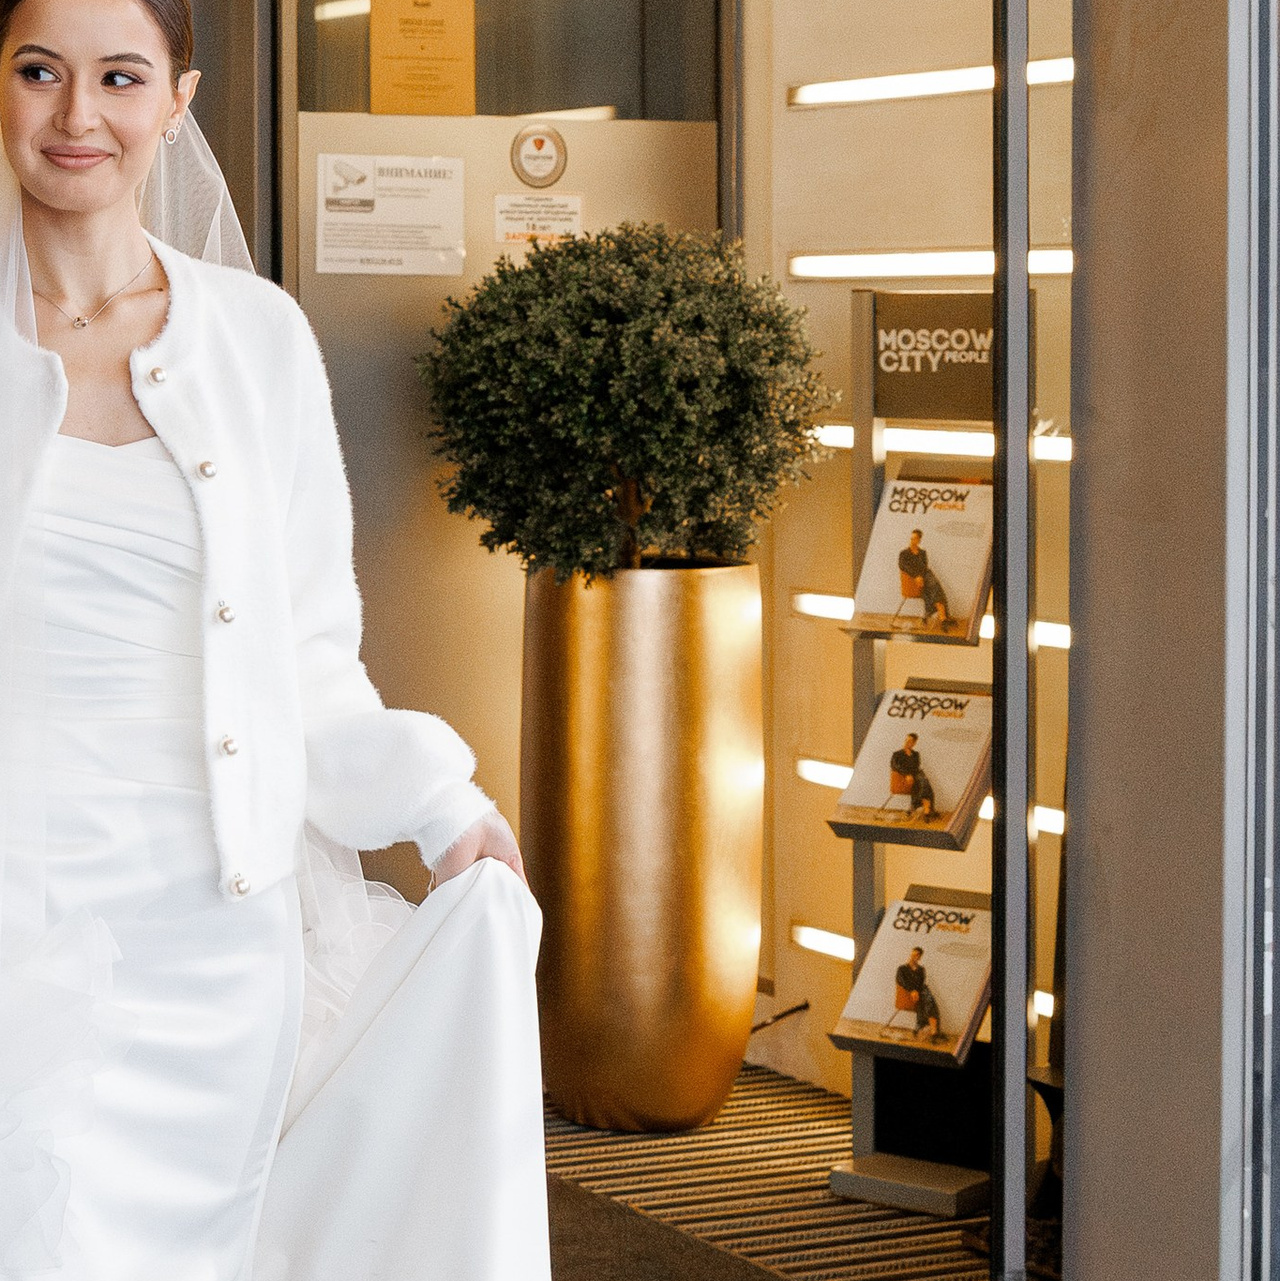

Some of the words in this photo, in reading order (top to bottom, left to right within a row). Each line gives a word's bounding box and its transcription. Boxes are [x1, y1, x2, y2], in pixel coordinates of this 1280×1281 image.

[878, 327, 993, 351] MOSCOW
[879, 351, 941, 373] CITY
[944, 351, 989, 363] PEOPLE
[890, 487, 971, 503] MOSCOW
[888, 499, 933, 514] CITY
[891, 694, 971, 711] MOSCOW
[886, 705, 931, 721] CITY
[896, 906, 976, 925] MOSCOW
[892, 918, 936, 934] CITY
